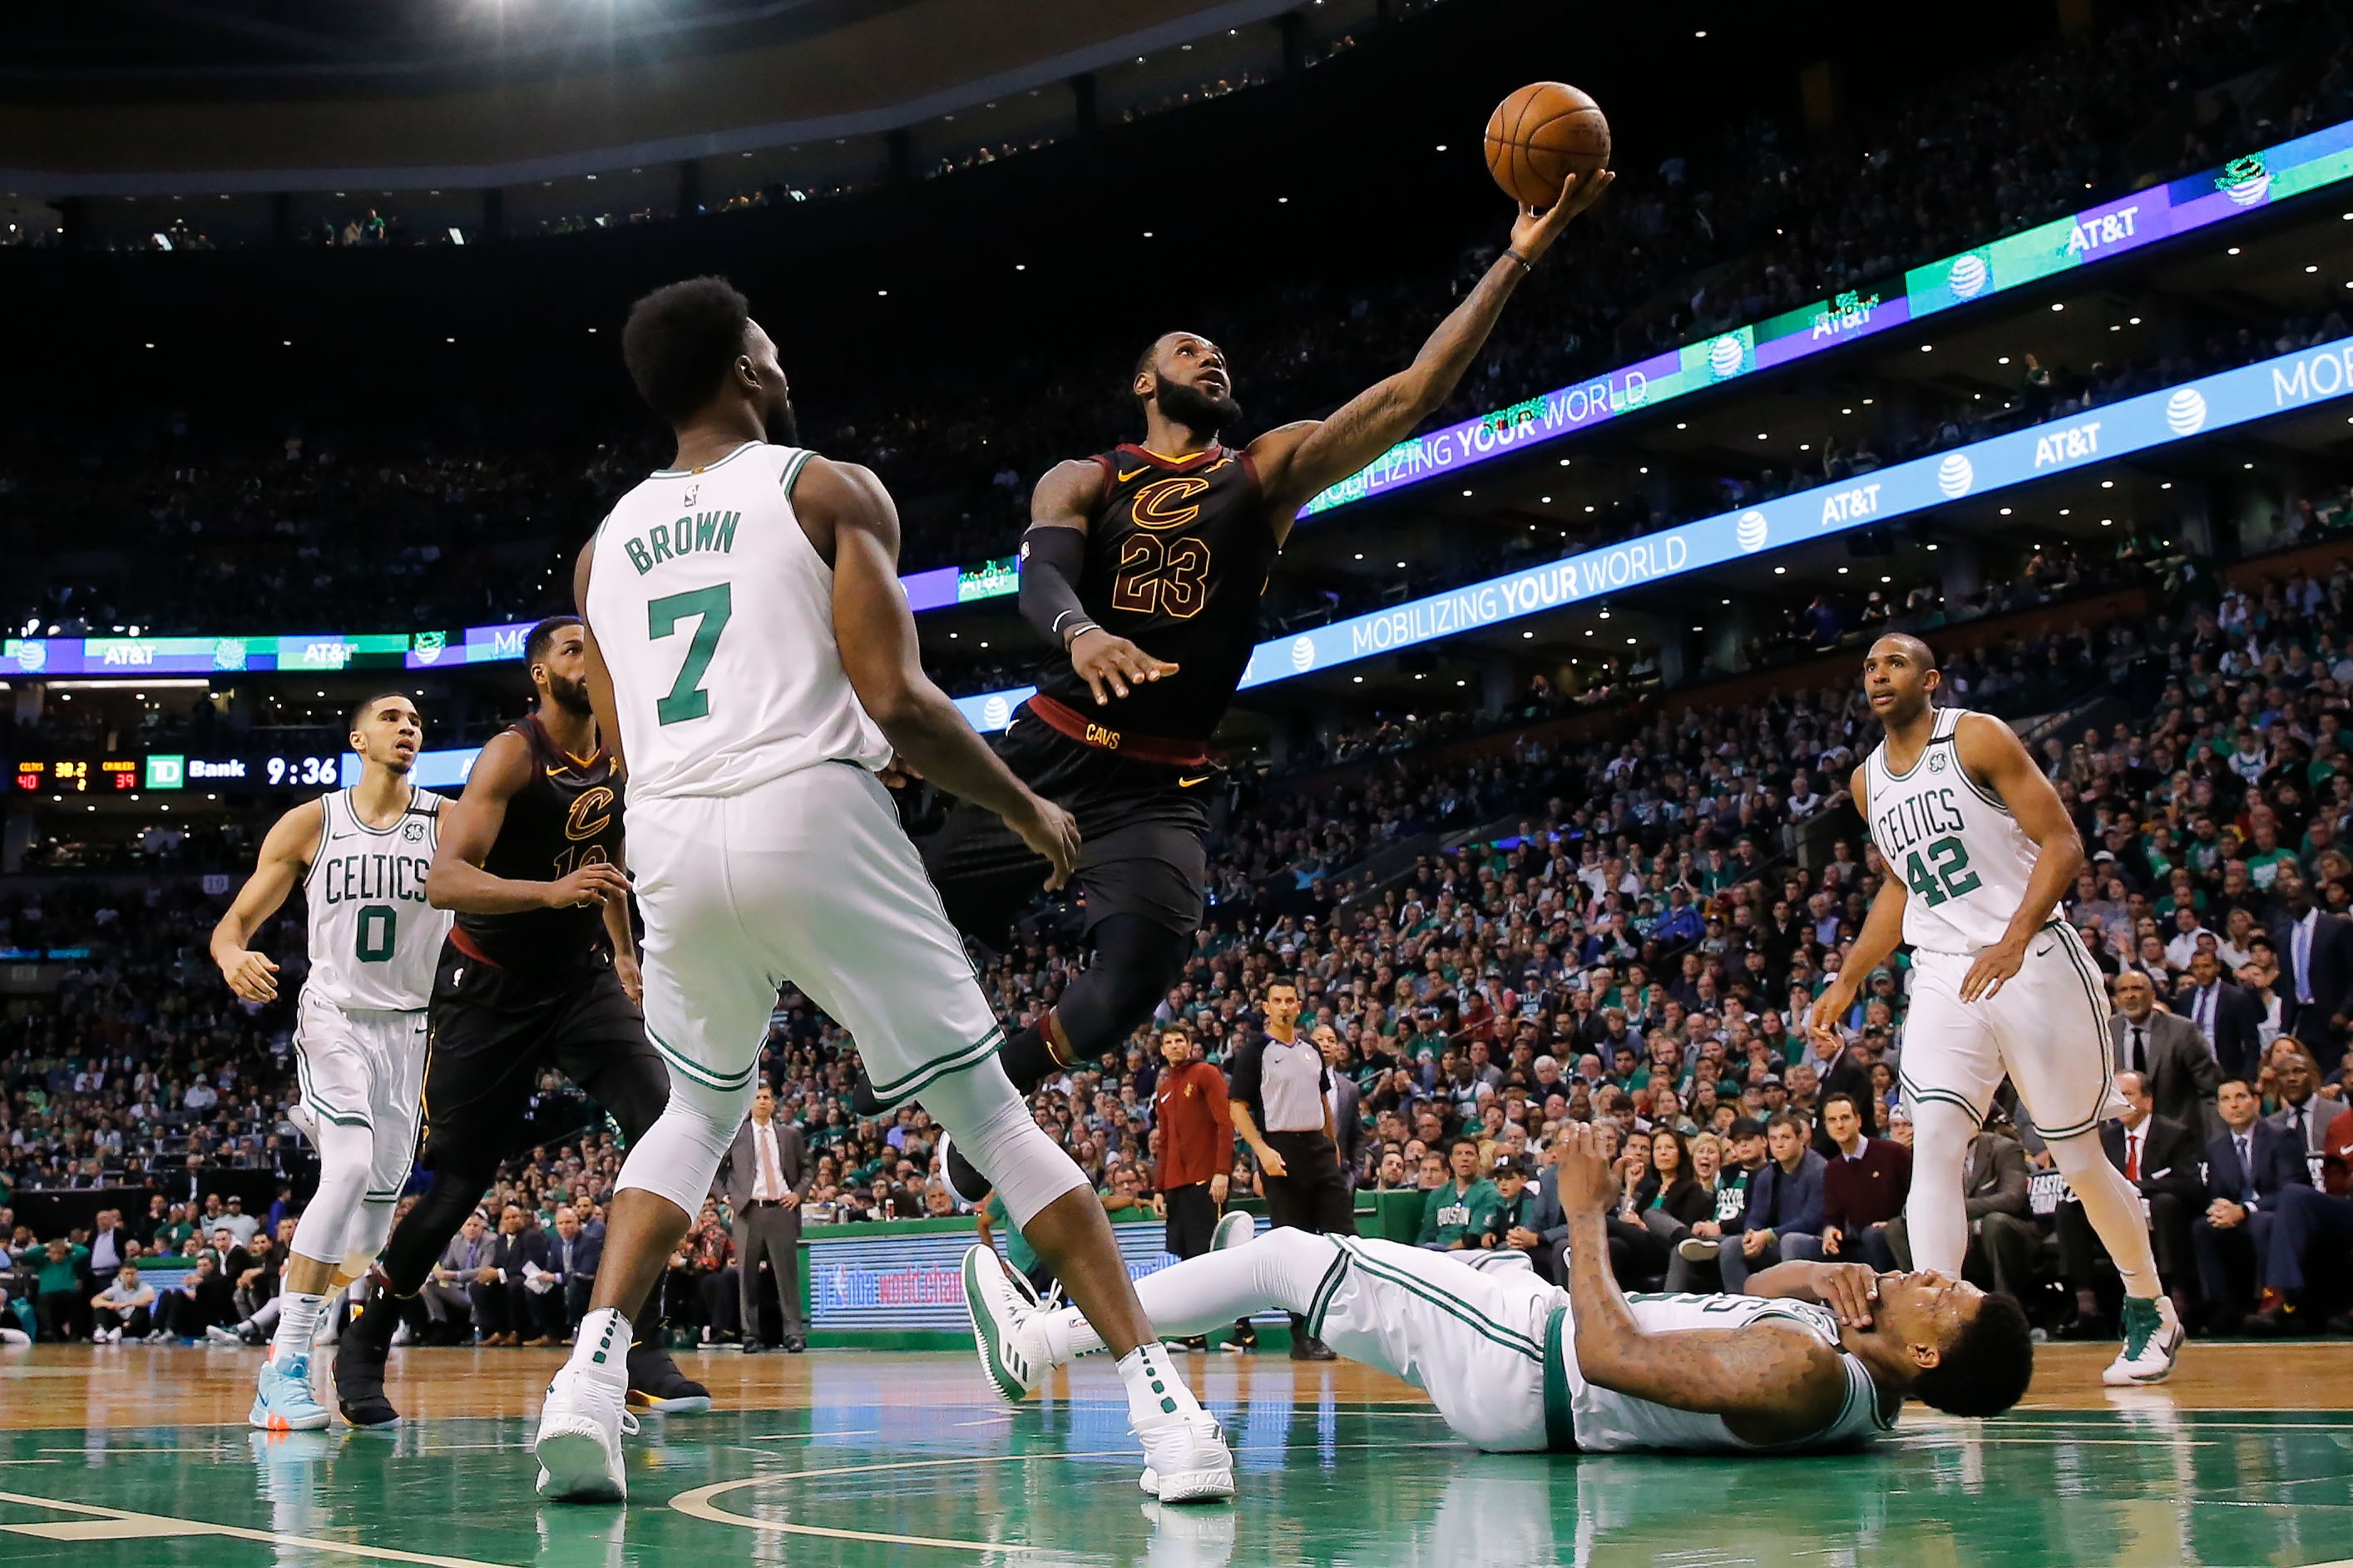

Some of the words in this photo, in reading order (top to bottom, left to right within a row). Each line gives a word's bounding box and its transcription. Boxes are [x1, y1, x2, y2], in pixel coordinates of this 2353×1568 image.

[2068, 205, 2139, 256] AT&T
[1545, 371, 1647, 430] WORLD
[2034, 423, 2101, 468] AT&T
[1822, 484, 1881, 526] AT&T
[625, 511, 740, 576] BROWN
[1113, 533, 1210, 618] 23
[1352, 588, 1496, 655] MOBILIZING
[1501, 566, 1579, 614] YOUR
[1583, 535, 1688, 591] WORLD
[104, 646, 156, 665] AT&T
[304, 644, 357, 662] AT&T
[648, 581, 731, 726] 7
[1085, 723, 1120, 749] CAVS
[17, 774, 38, 789] 40
[116, 774, 136, 789] 39
[149, 760, 181, 783] TD
[189, 759, 245, 778] Bank
[266, 757, 337, 785] 9:36
[1877, 788, 1965, 860] CELTICS
[326, 853, 429, 904] CELTICS
[1906, 835, 1983, 908] 42
[356, 904, 397, 963] 0
